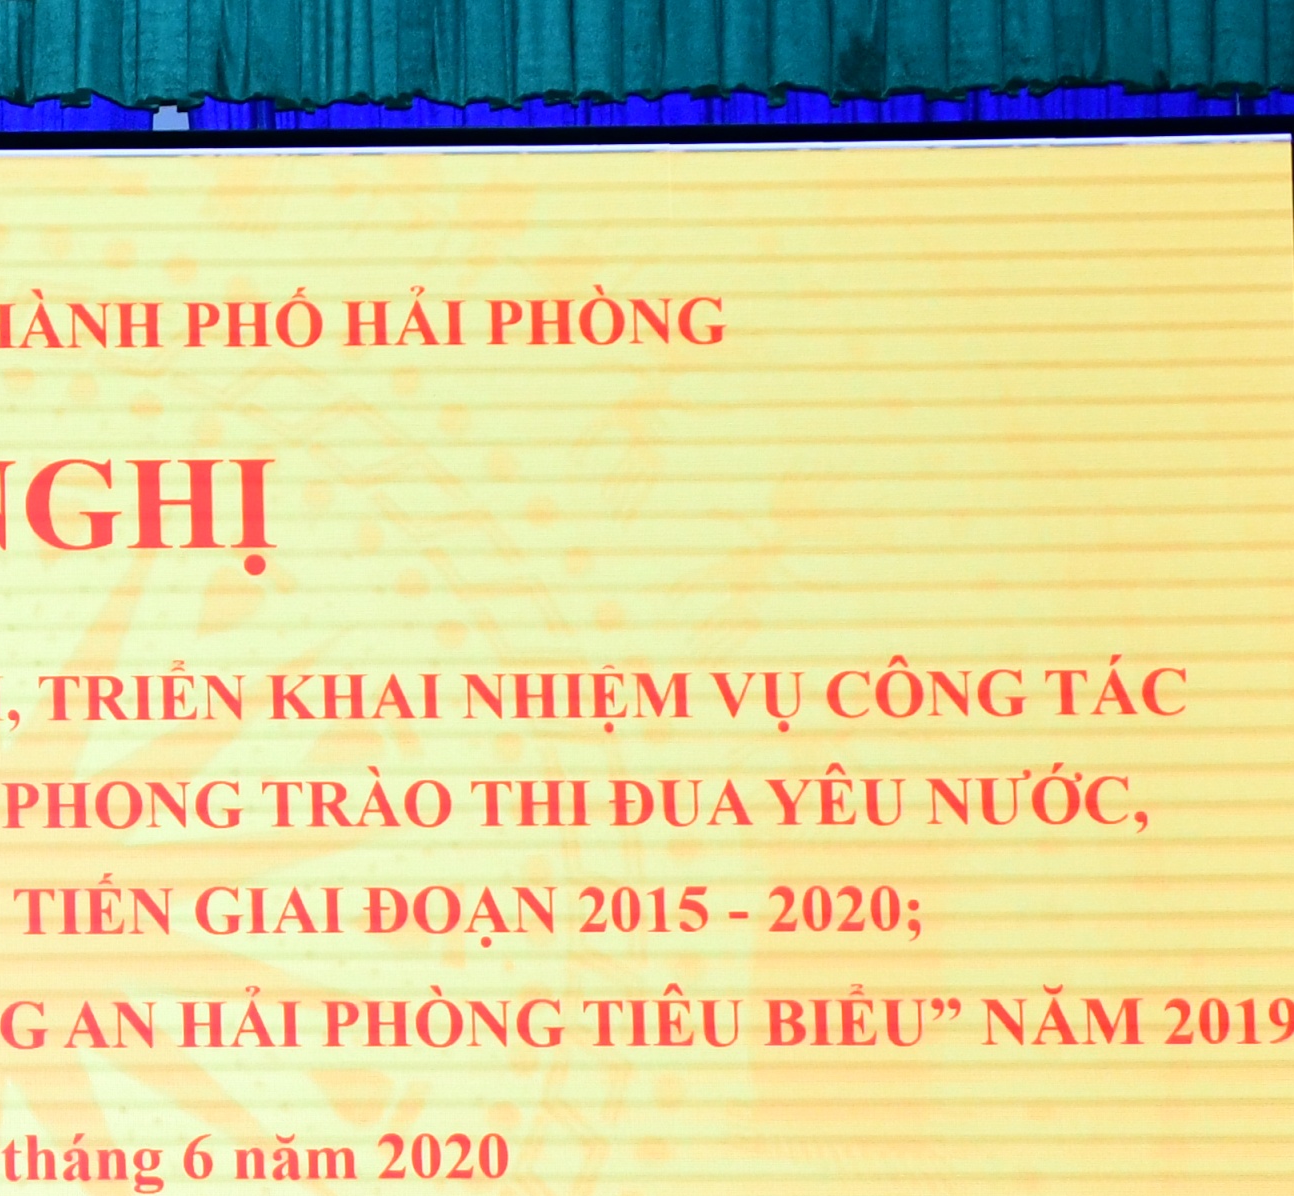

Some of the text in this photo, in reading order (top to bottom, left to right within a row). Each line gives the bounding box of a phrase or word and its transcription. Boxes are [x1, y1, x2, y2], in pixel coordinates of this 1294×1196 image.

[185, 286, 324, 349] PHỐ
[344, 285, 464, 347] HẢI
[487, 284, 726, 346] PHÒNG
[38, 665, 243, 721] TRIỂN
[269, 673, 440, 720] KHAI
[464, 672, 690, 735] NHIỆM
[710, 671, 803, 734] VỤ
[825, 654, 1027, 719] CÔNG
[1044, 653, 1187, 717] TÁC
[3, 780, 242, 830] PHONG
[261, 765, 453, 828] TRÀO
[470, 779, 589, 827] THI
[609, 778, 754, 828] ĐUA
[766, 761, 905, 827] YÊU
[926, 761, 1149, 833] NƯỚC,
[13, 872, 173, 936] TIẾN
[194, 885, 342, 935] GIAI
[364, 885, 556, 949] ĐOẠN
[579, 885, 710, 933] 2015
[768, 884, 922, 941] 2020;
[63, 1000, 154, 1049] AN
[180, 985, 301, 1048] HẢI
[323, 984, 565, 1049] PHÒNG
[582, 982, 741, 1048] TIÊU
[764, 983, 962, 1048] BIỂU”
[981, 984, 1145, 1046] NĂM
[1164, 996, 1294, 1045] 2019
[2, 1132, 165, 1195] tháng
[183, 1134, 214, 1181] 6
[235, 1134, 358, 1182] năm
[377, 1132, 509, 1181] 2020
